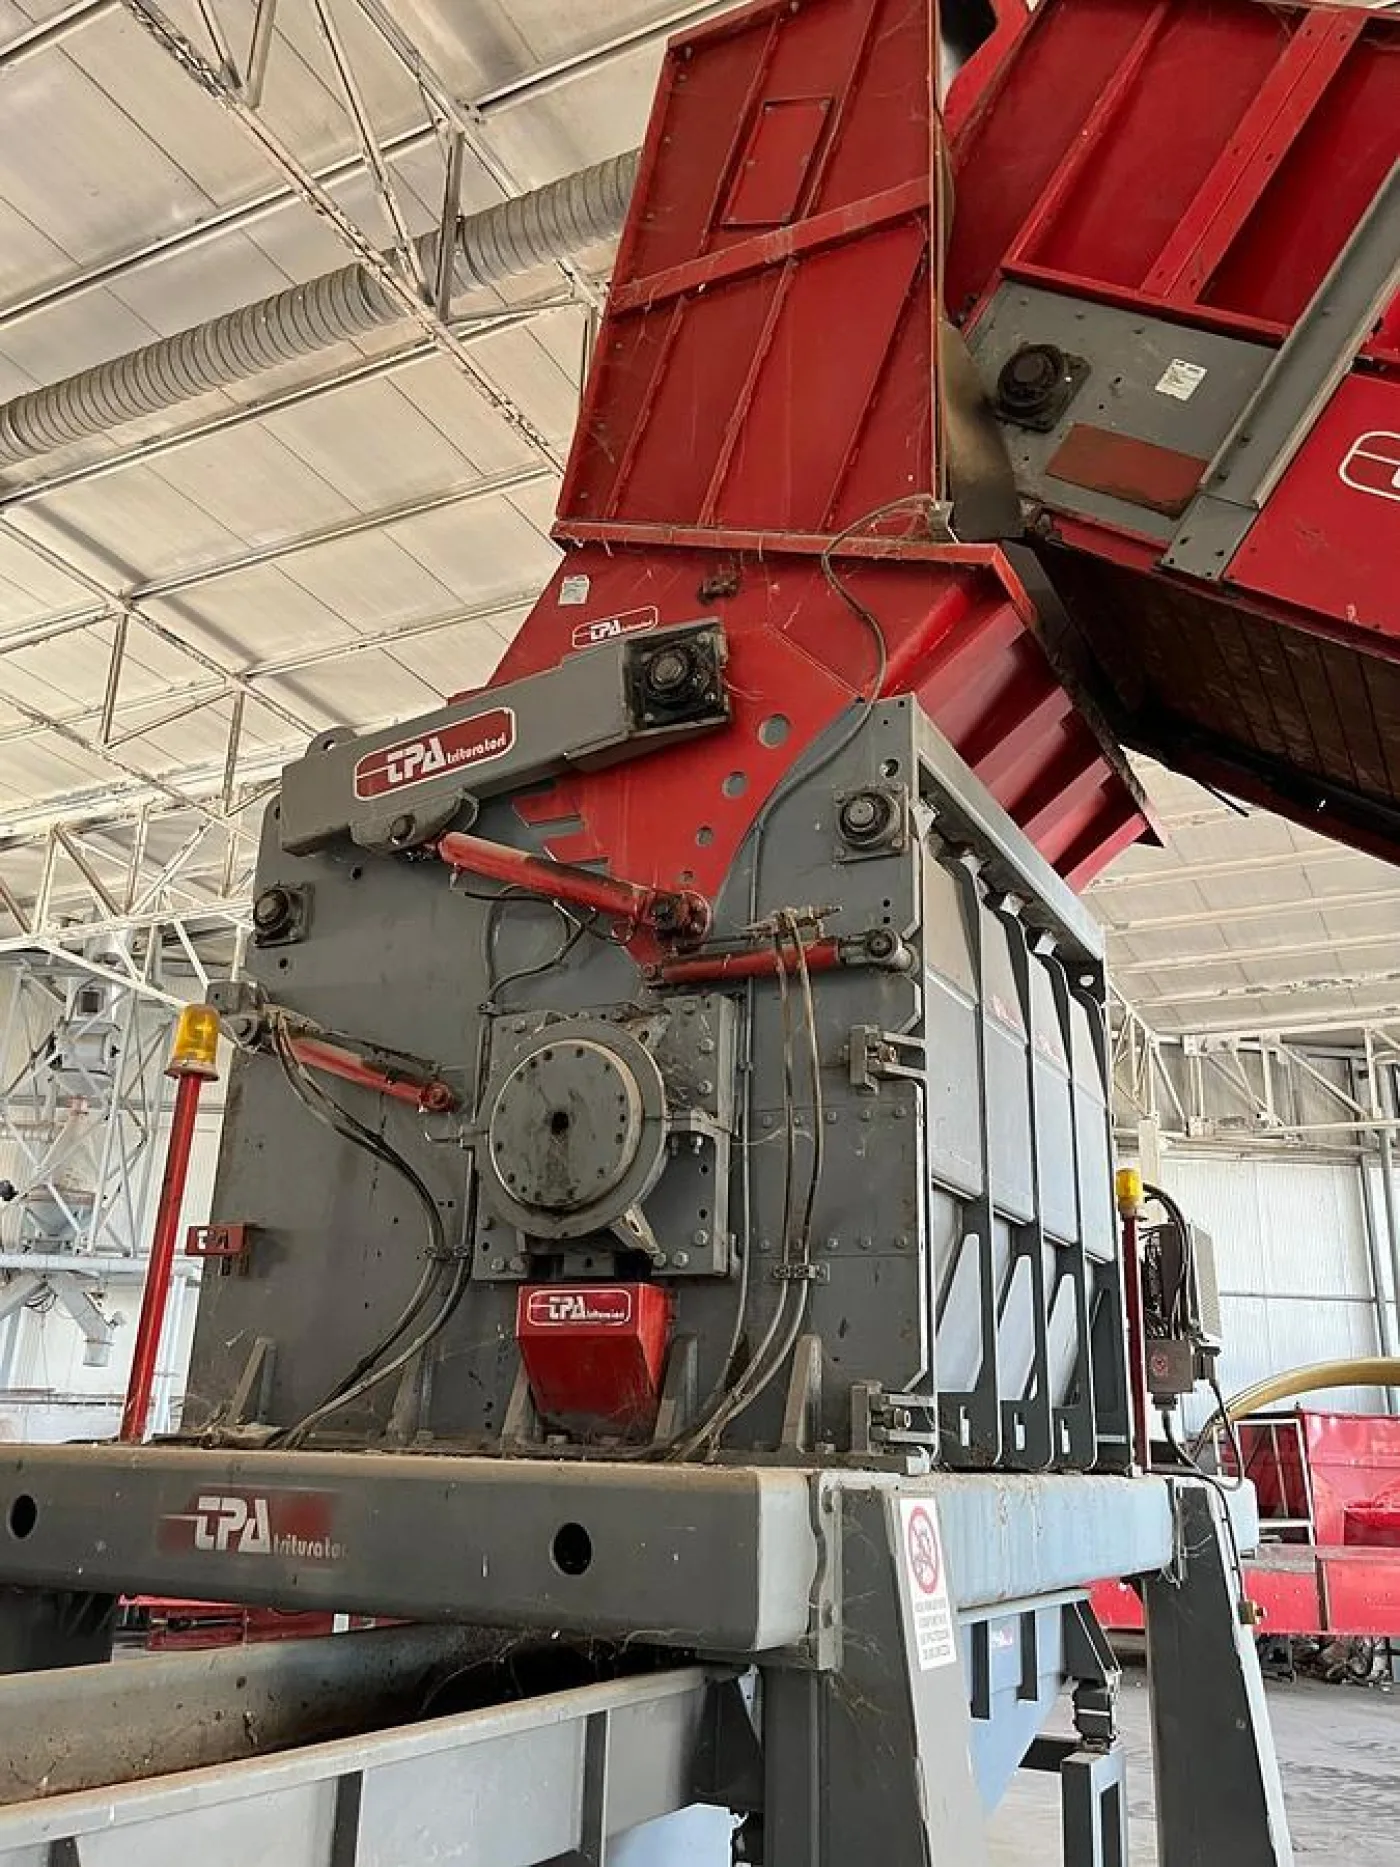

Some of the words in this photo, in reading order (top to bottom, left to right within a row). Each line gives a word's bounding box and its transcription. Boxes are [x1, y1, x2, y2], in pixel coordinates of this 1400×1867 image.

[590, 619, 621, 640] TPA
[387, 736, 447, 783] TPA
[549, 1296, 586, 1320] TPA
[195, 1495, 271, 1553] TPA
